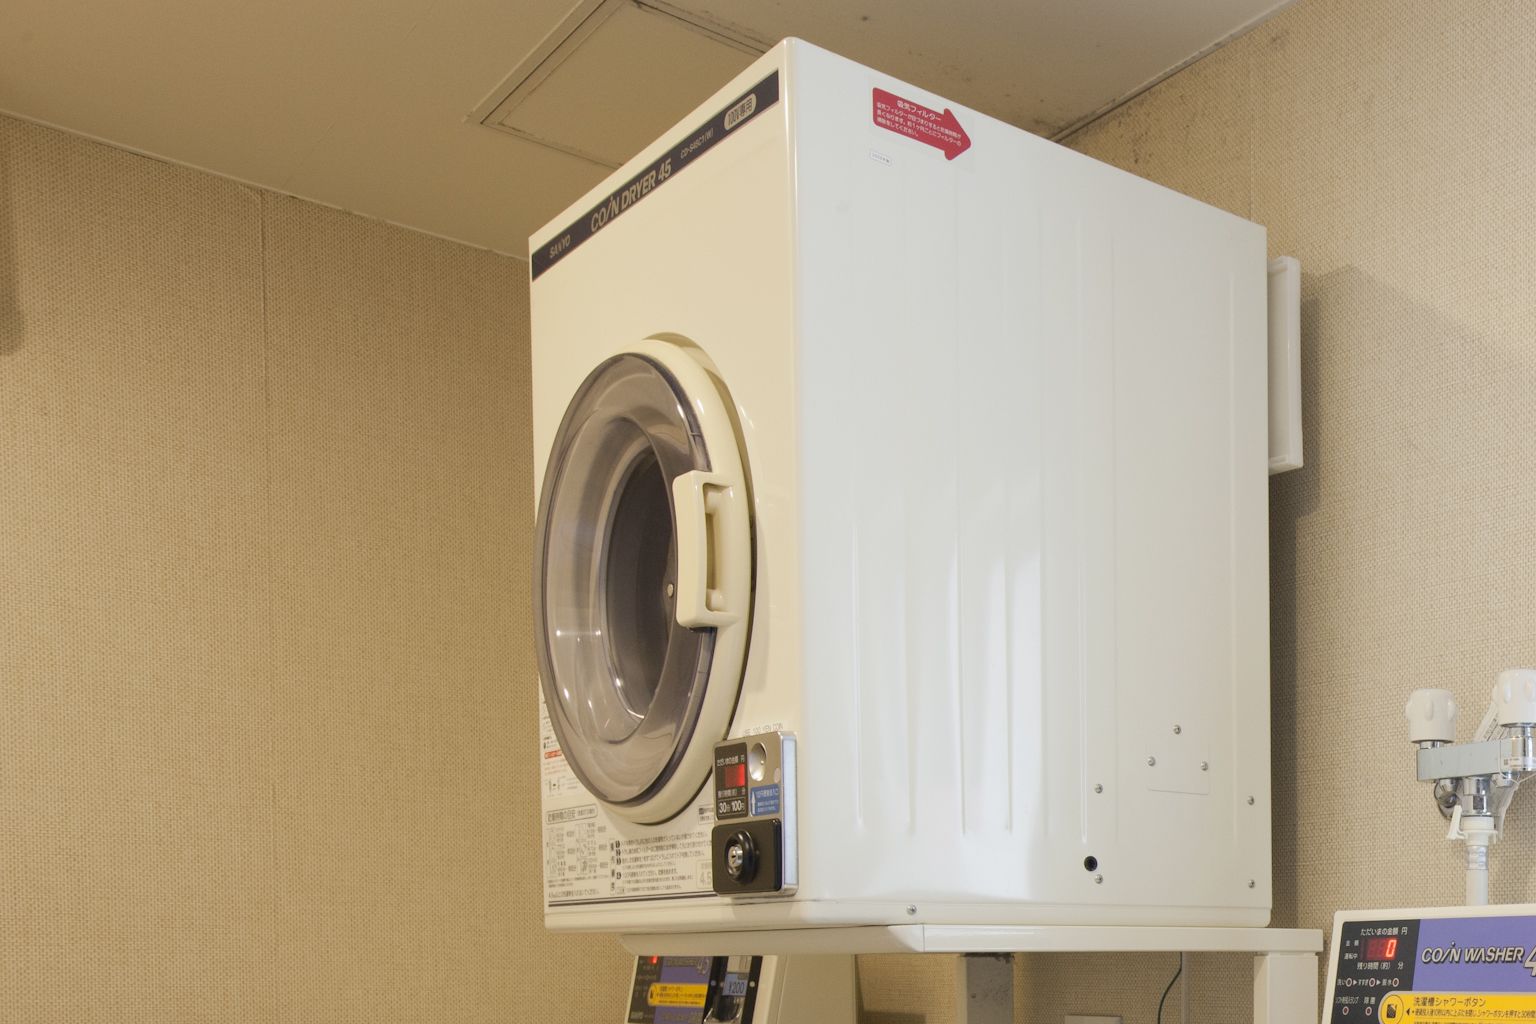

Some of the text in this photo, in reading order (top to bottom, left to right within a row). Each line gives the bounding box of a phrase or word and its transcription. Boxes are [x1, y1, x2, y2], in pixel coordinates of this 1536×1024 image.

[591, 158, 672, 232] COIN DRYER 45
[550, 234, 571, 259] SANYO
[1386, 939, 1397, 958] 0
[1421, 941, 1462, 964] COIN
[1464, 945, 1525, 966] WASHER
[1414, 997, 1487, 1007] 洗濯槽シャワーボタン
